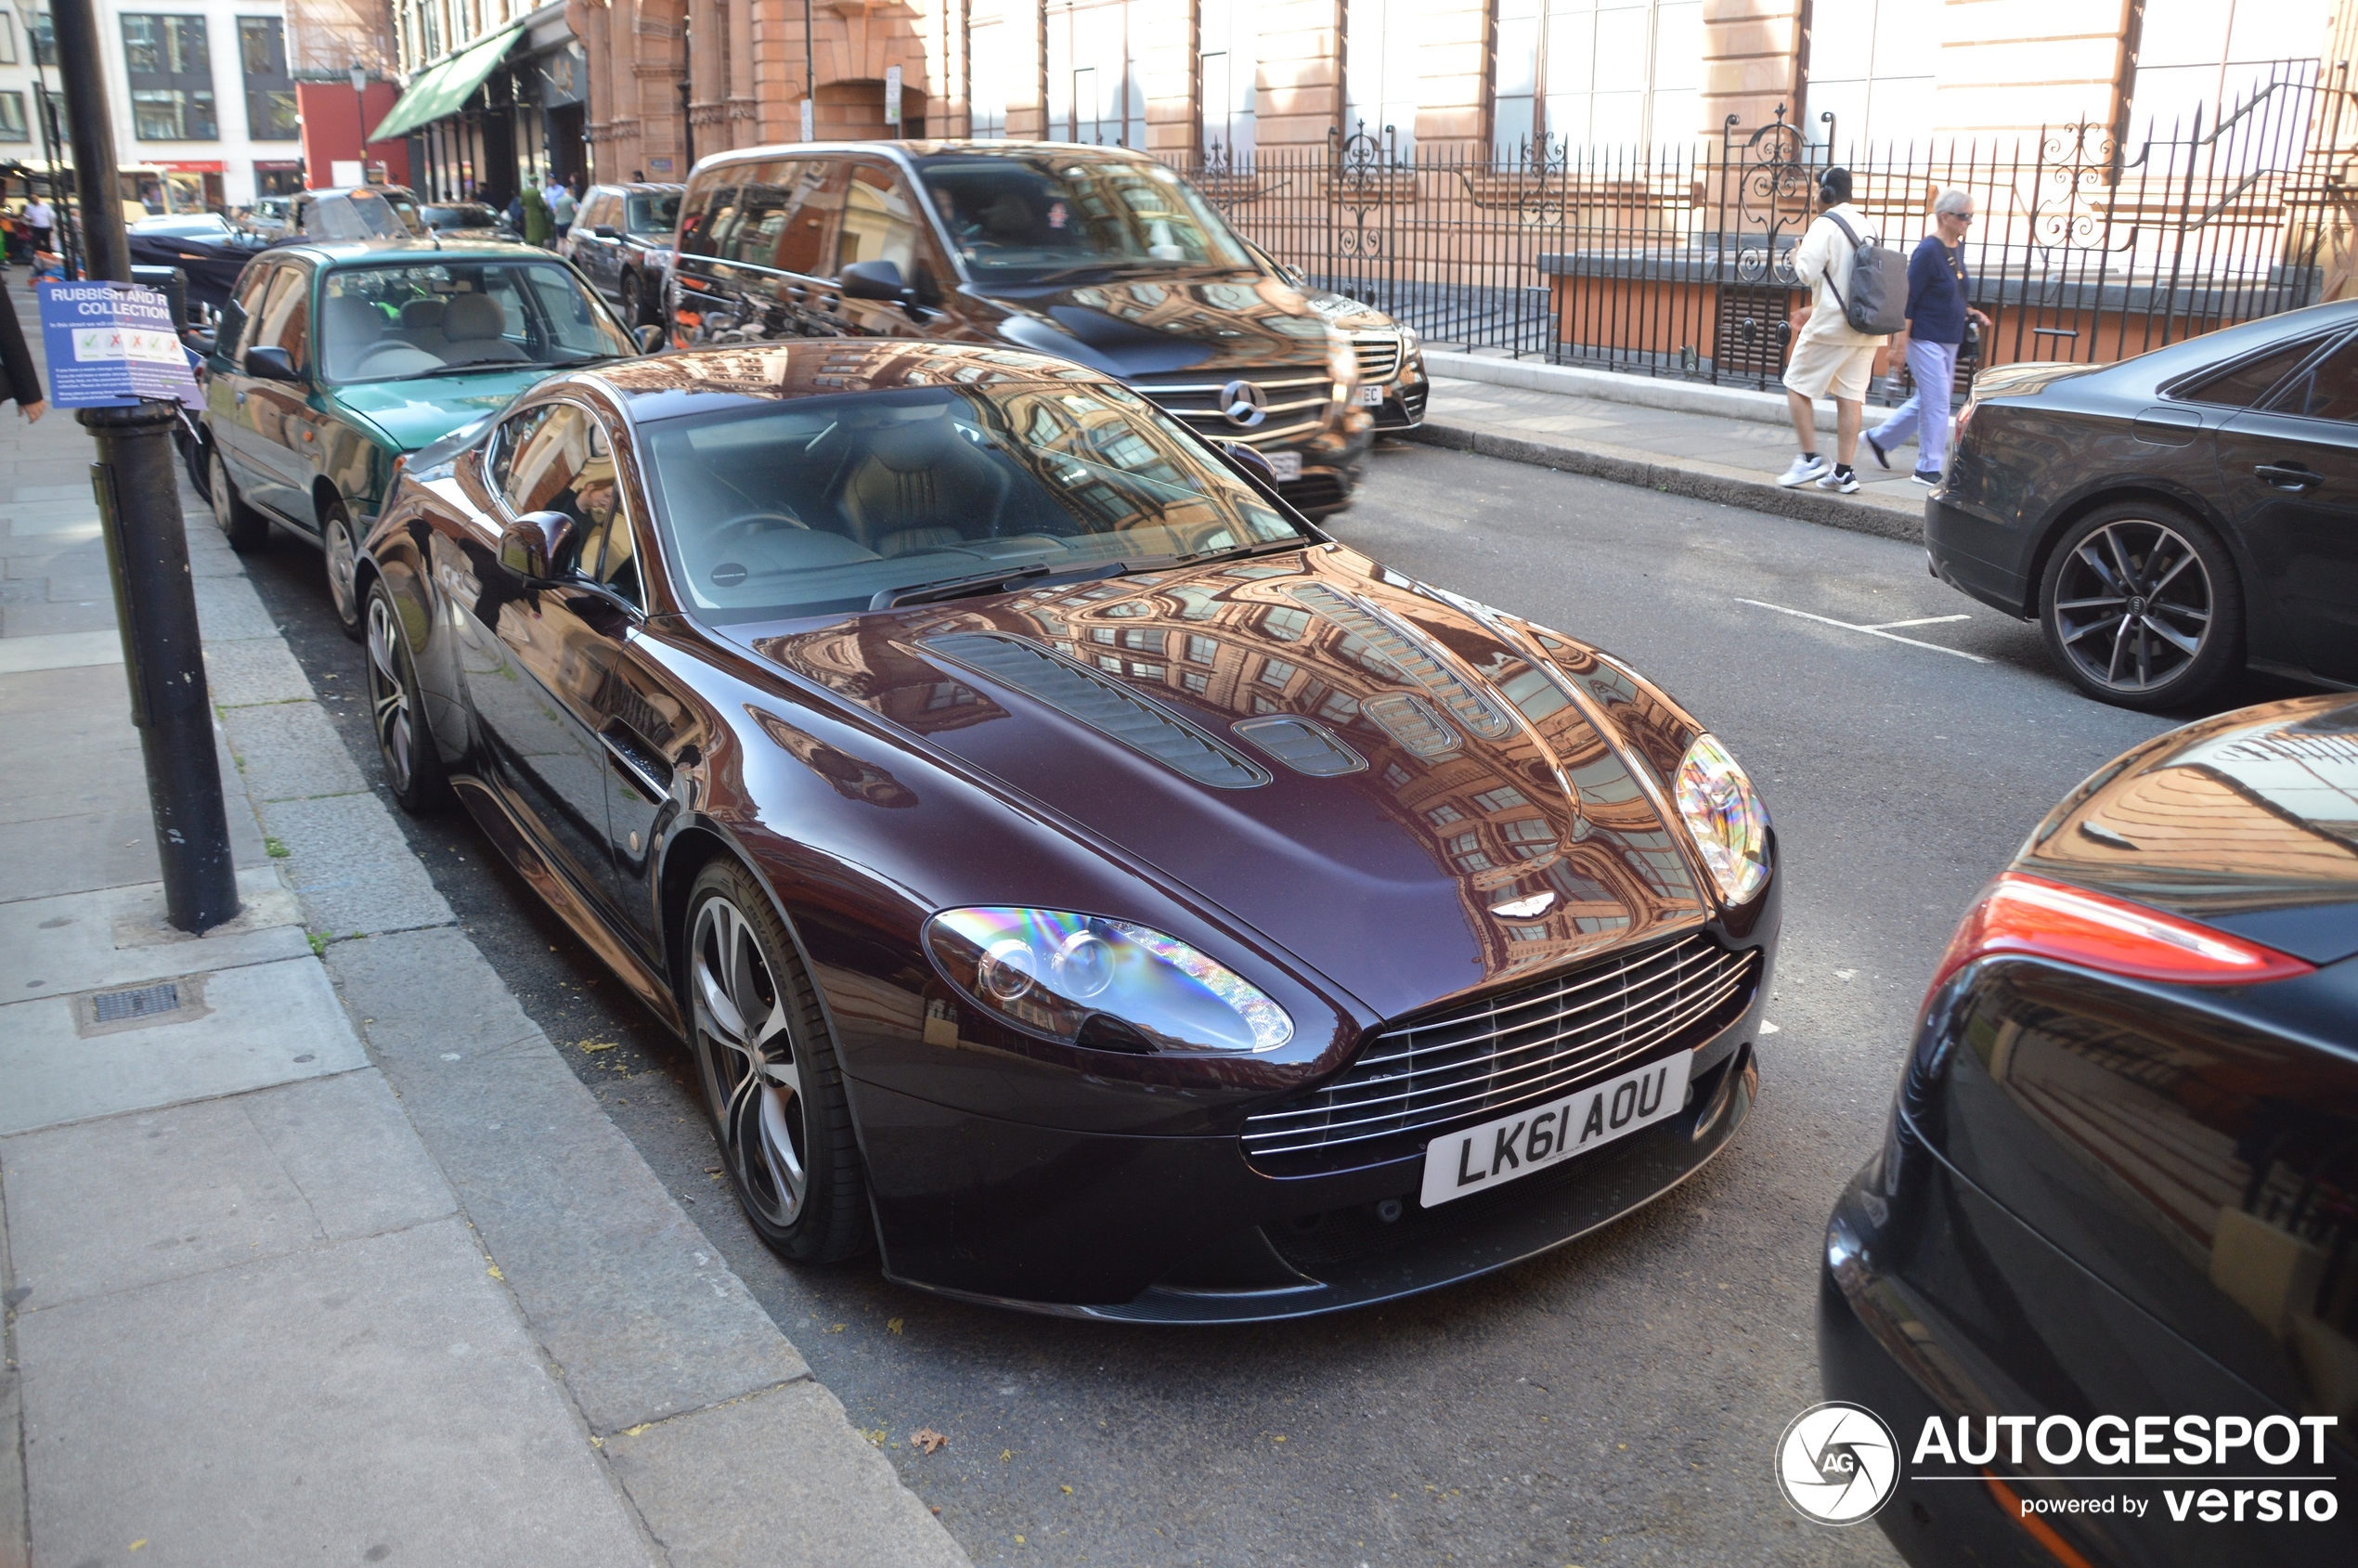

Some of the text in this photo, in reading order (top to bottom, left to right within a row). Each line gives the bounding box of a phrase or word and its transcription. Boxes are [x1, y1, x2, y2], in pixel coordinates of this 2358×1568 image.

[50, 287, 124, 302] RUBBISH
[127, 290, 155, 305] AND
[78, 302, 171, 320] COLLECTION
[1457, 1067, 1667, 1187] LK61 AOU
